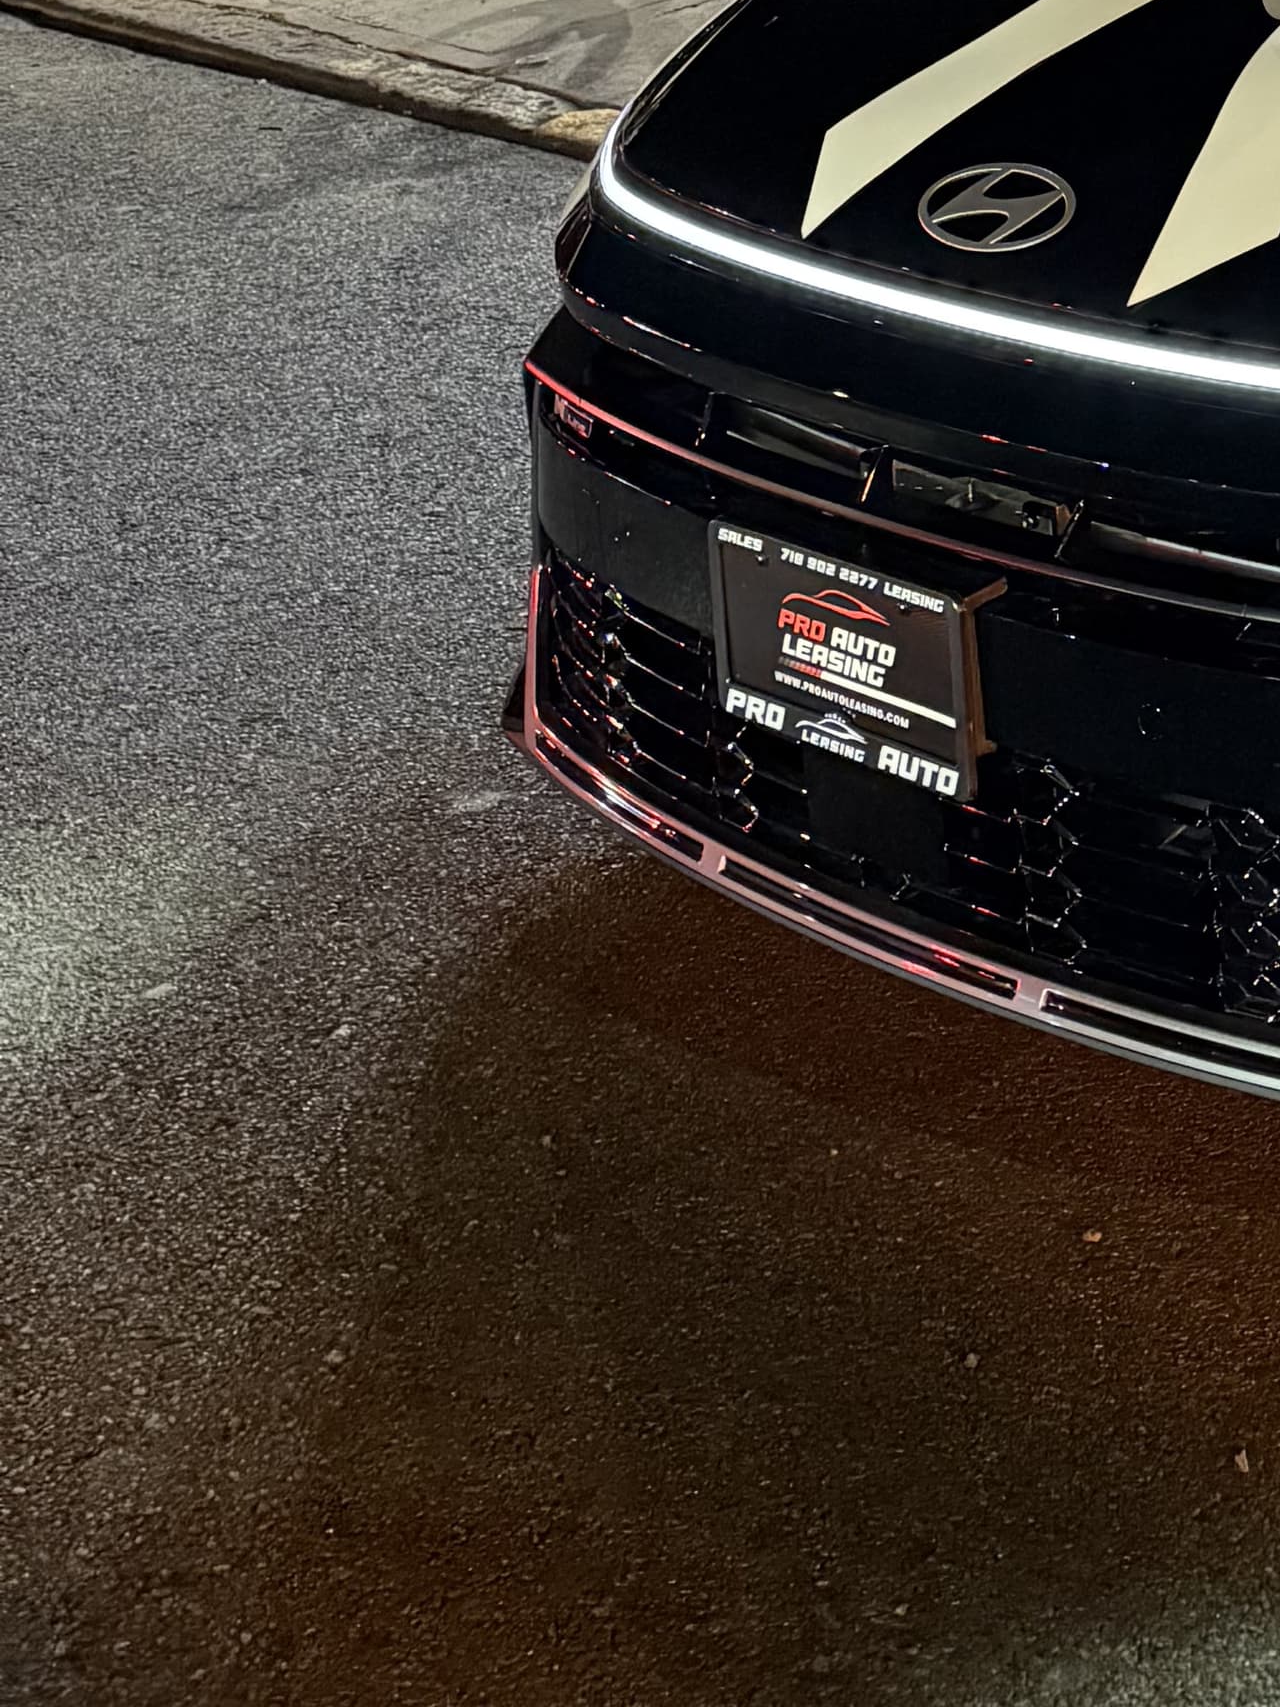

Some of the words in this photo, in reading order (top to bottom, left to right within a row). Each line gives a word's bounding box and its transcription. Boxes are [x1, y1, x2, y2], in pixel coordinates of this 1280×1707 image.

[718, 527, 763, 552] SALES
[780, 548, 804, 566] 718
[807, 555, 836, 576] 902
[839, 563, 879, 589] 2277
[883, 581, 945, 613] LEASING
[777, 608, 827, 642] PRO
[830, 626, 896, 668] AUTO
[782, 633, 887, 688] LEASING
[725, 688, 786, 731] PRO
[801, 729, 865, 763] LEASING
[877, 744, 959, 796] AUTO
